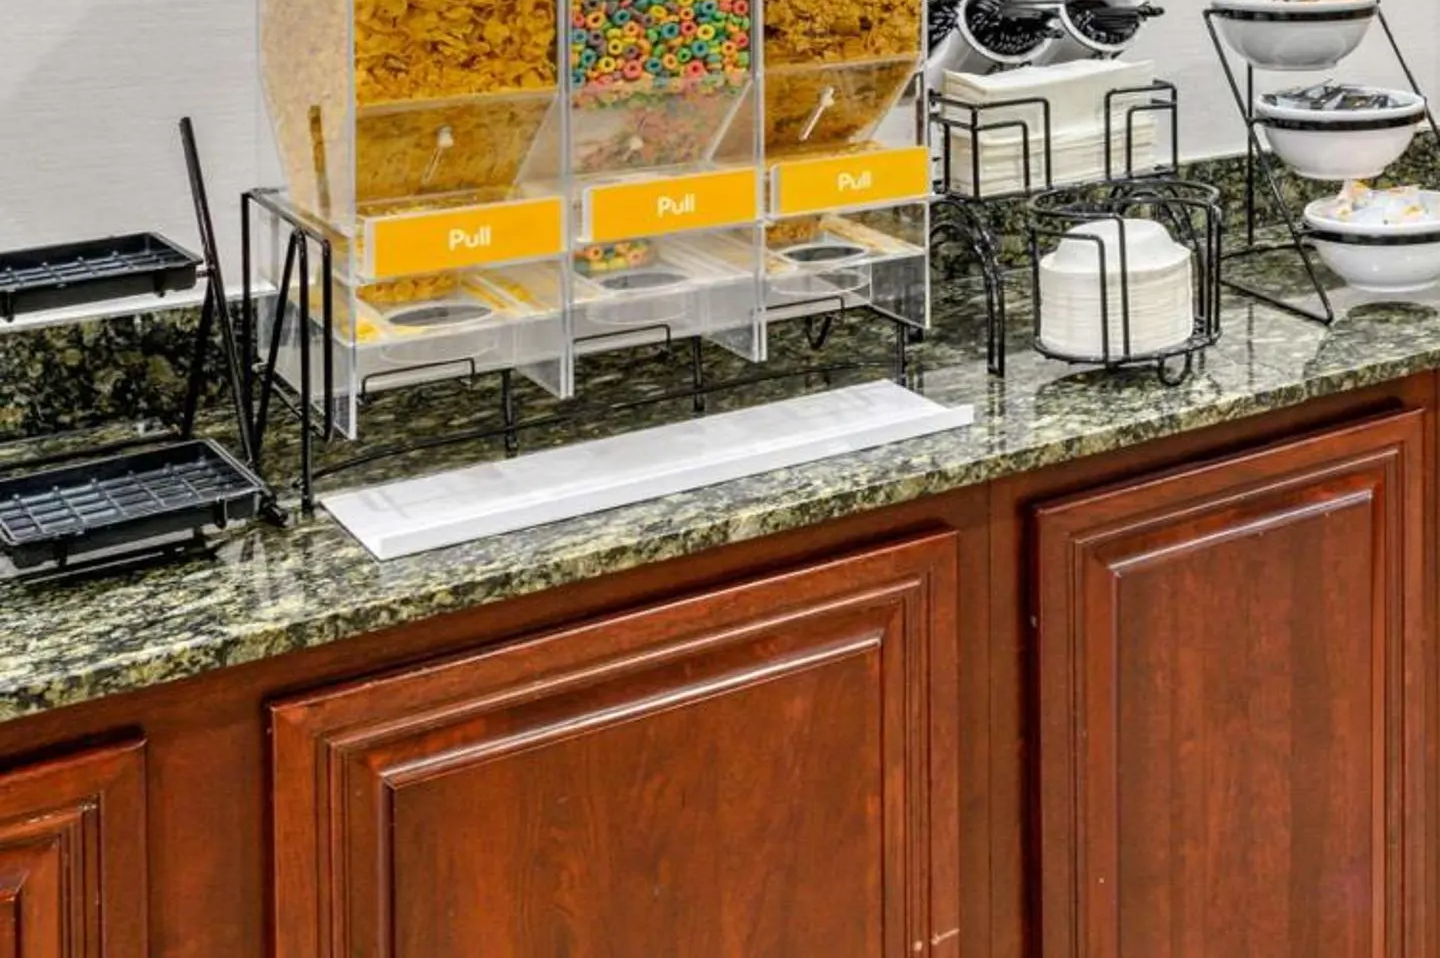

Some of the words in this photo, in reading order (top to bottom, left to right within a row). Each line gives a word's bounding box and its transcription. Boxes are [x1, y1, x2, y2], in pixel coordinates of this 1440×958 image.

[838, 170, 872, 191] Pull
[657, 194, 696, 217] Pull
[449, 227, 491, 250] Pull
